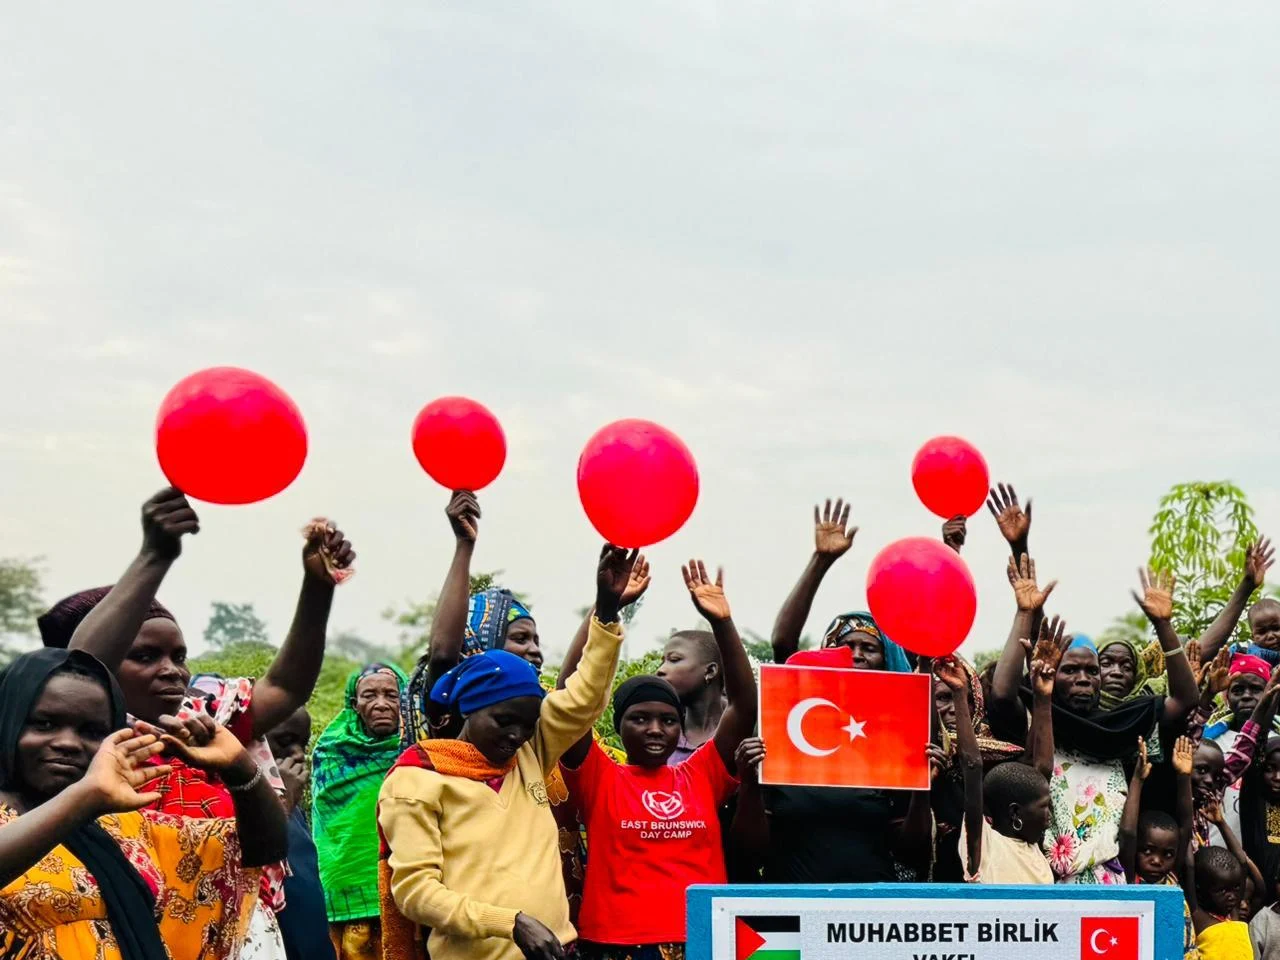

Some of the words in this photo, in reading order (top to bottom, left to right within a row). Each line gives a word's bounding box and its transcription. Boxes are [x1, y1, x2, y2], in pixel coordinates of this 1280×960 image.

[621, 820, 648, 829] EAST
[651, 820, 706, 830] BRUNSWICK
[640, 831, 660, 839] DAY
[663, 830, 692, 839] CAMP
[827, 922, 968, 943] MUHABBET
[977, 917, 1059, 942] BİRLİK
